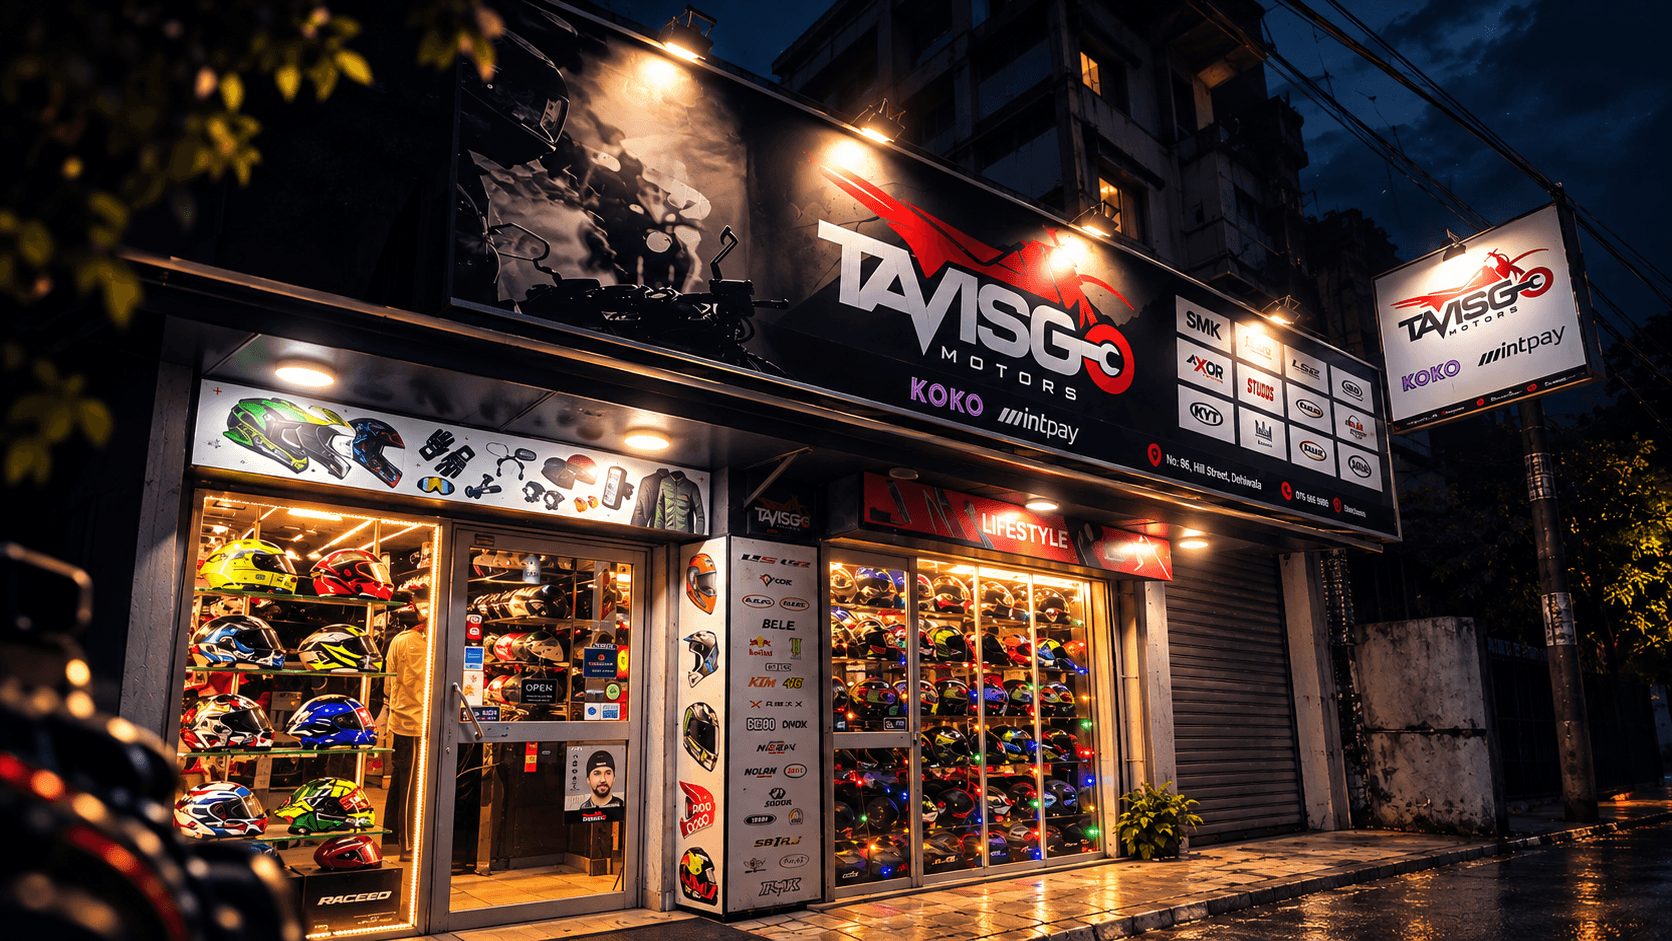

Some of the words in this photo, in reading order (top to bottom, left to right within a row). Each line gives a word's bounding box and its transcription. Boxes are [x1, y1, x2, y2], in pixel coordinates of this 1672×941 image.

[1186, 310, 1222, 341] SMK
[1449, 305, 1518, 336] MOTORS
[941, 345, 1077, 400] MOTORS
[1186, 354, 1224, 380] AXOR
[1402, 359, 1461, 392] KOKO
[910, 376, 984, 417] KOKO
[1194, 405, 1220, 424] KYT
[1166, 453, 1180, 467] No:
[1193, 461, 1206, 475] Hill
[982, 512, 1069, 549] LIFESTYLE
[525, 683, 553, 692] OPEN
[748, 676, 777, 688] KTM
[317, 890, 393, 906] RACEED
